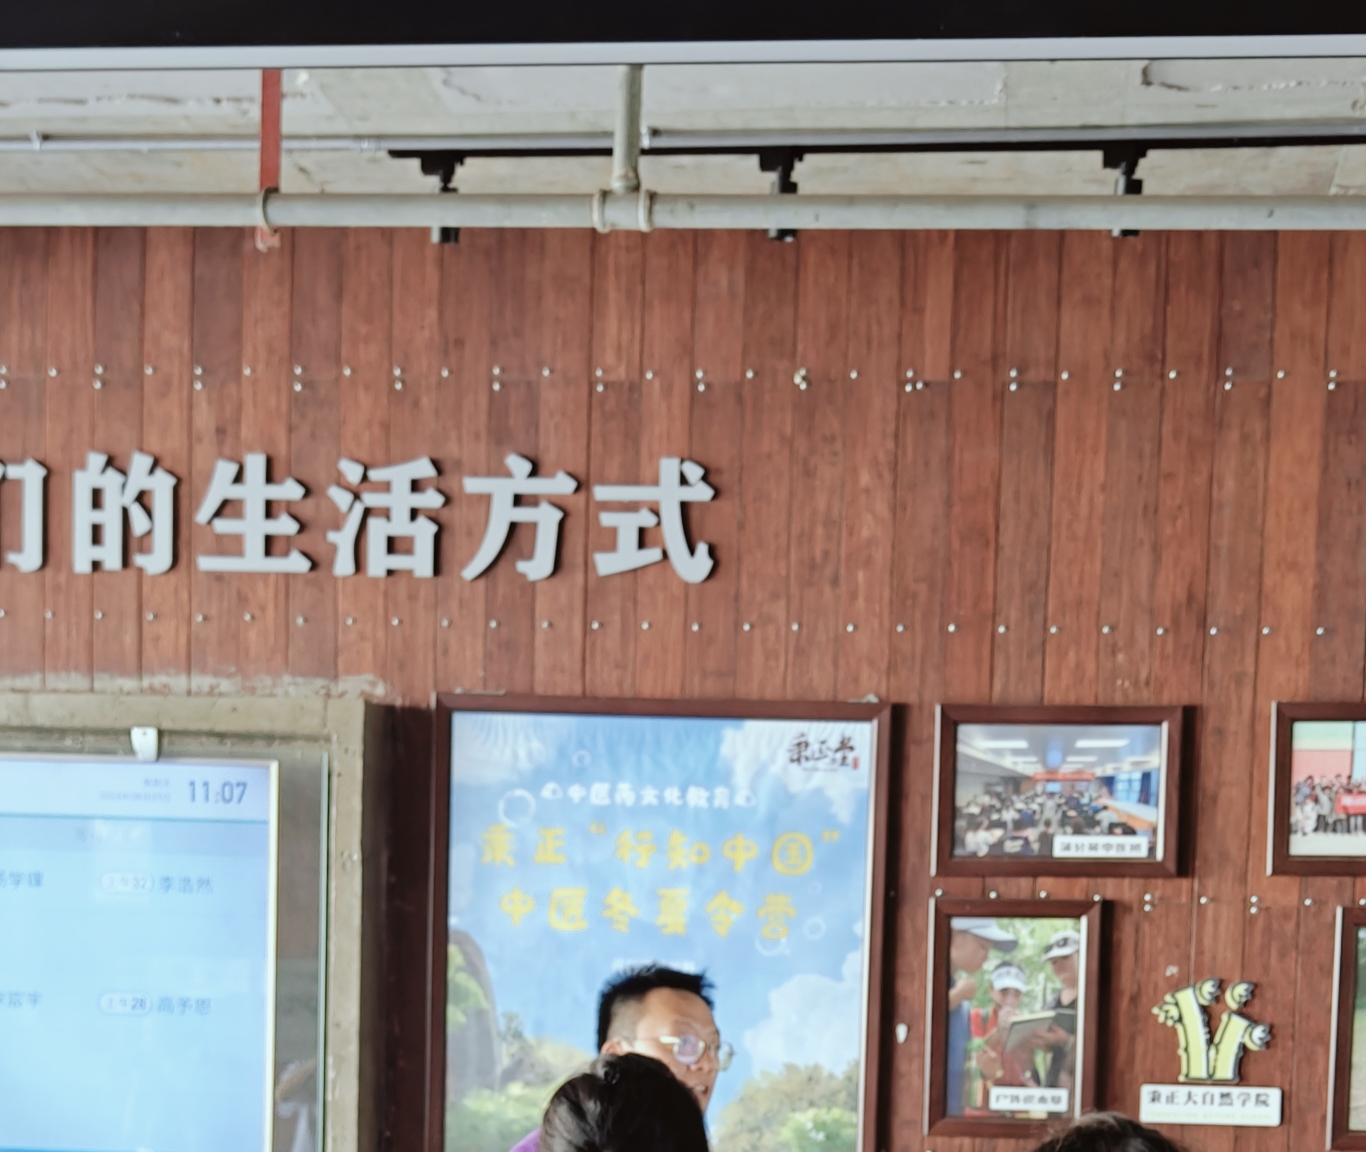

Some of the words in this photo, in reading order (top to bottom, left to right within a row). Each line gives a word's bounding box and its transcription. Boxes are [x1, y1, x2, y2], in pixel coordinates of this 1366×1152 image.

[189, 779, 248, 804] 11:07
[498, 886, 797, 939] 中医冬夏令营
[1147, 1090, 1271, 1108] 秉正大自然学院
